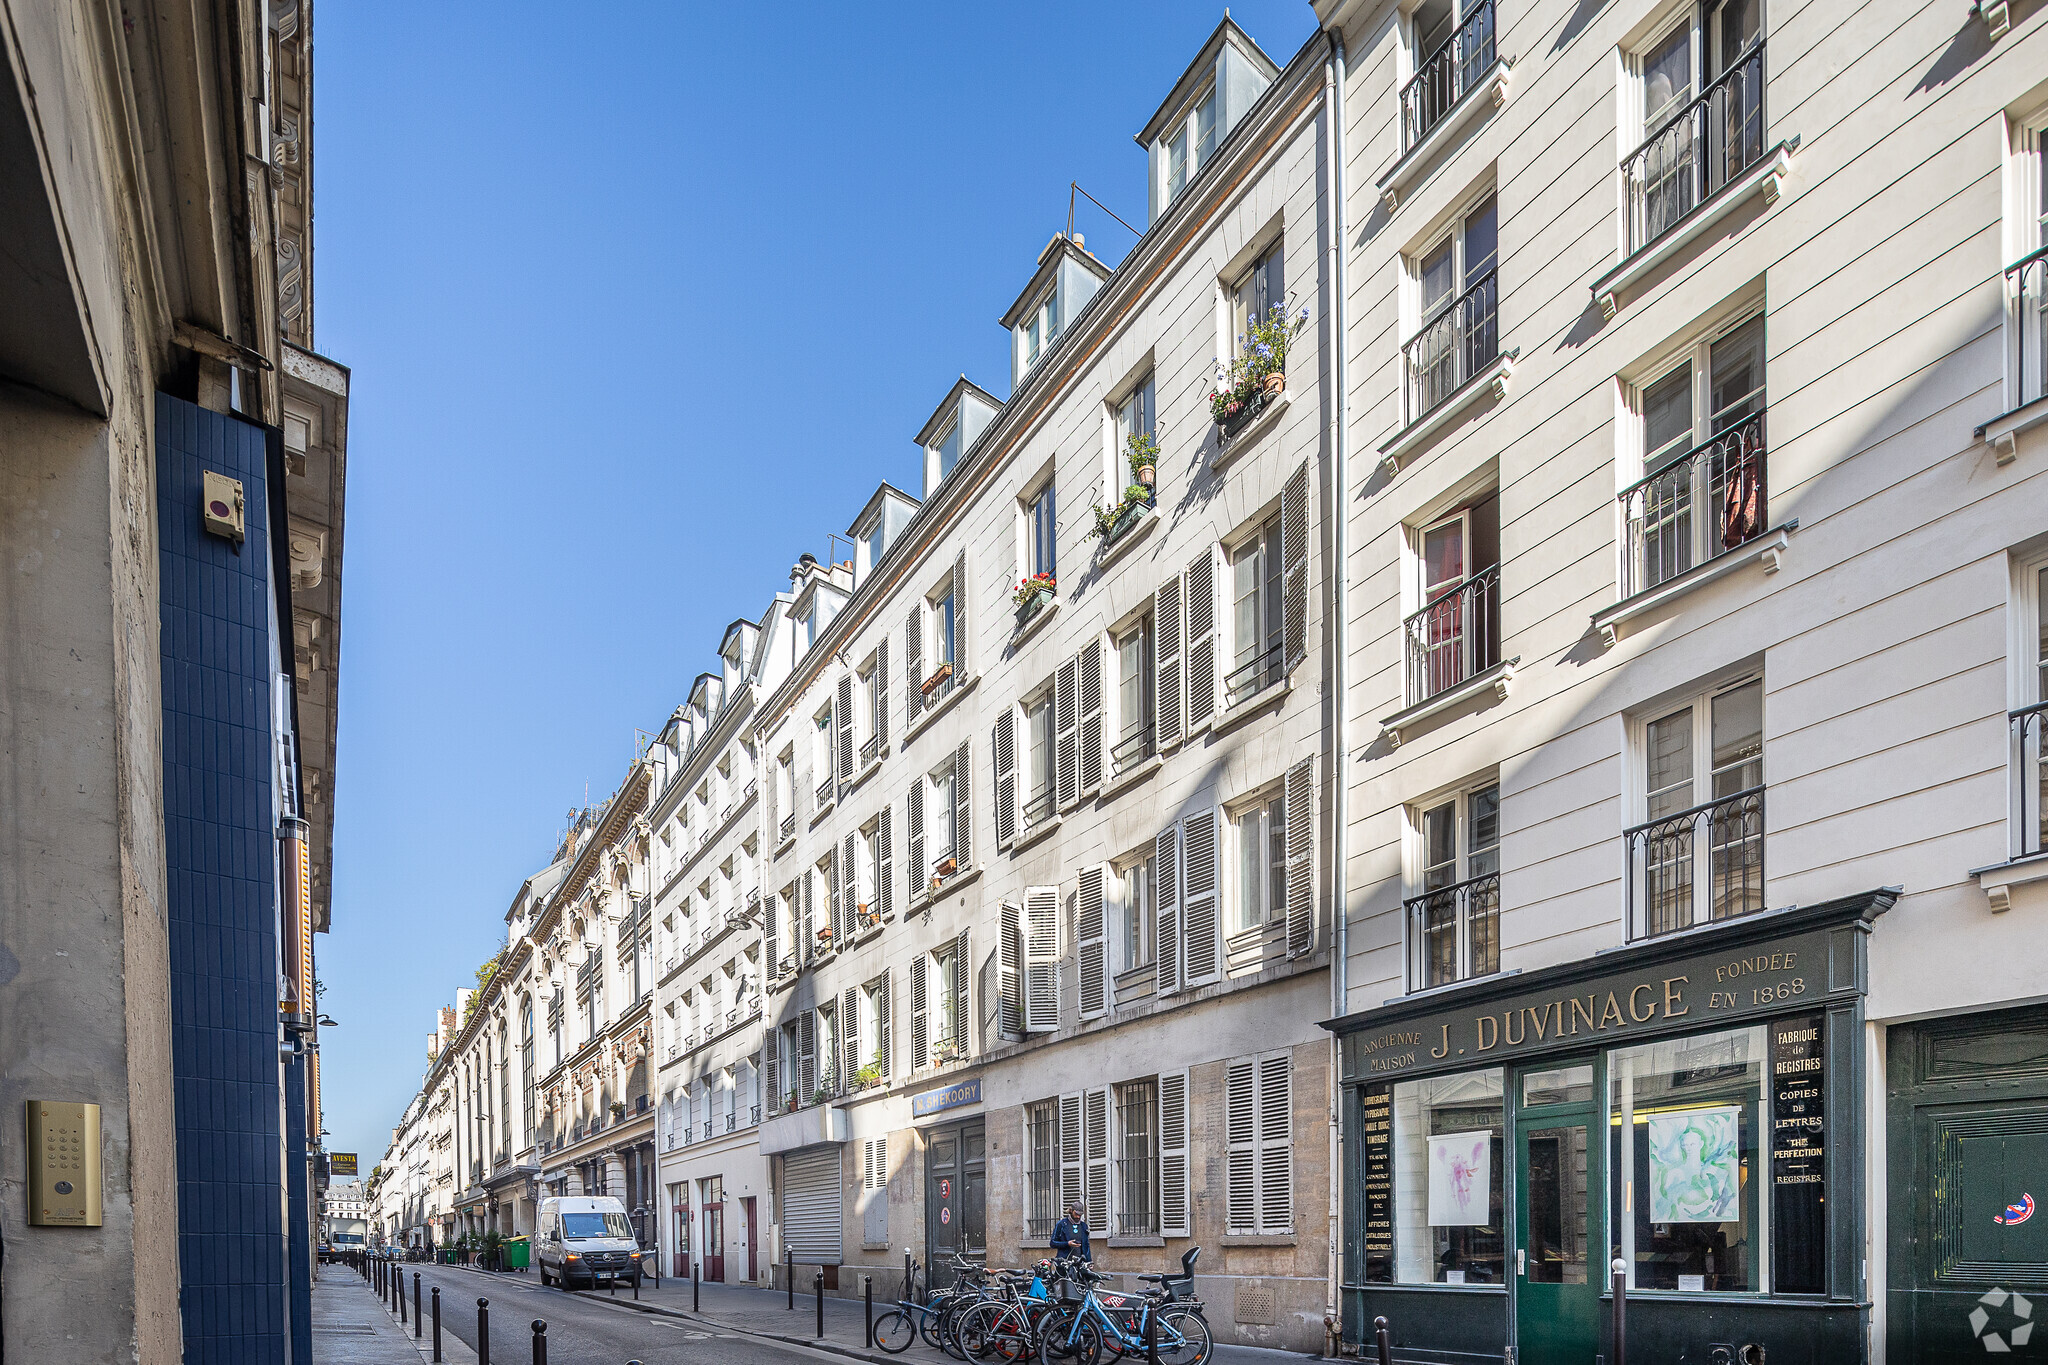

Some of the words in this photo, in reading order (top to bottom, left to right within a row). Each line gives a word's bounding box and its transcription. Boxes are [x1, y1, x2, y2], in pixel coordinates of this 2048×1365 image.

[1715, 949, 1798, 983] FONDÉE
[1708, 991, 1738, 1009] EN
[1752, 977, 1806, 1006] 1868
[1430, 1023, 1465, 1059] J.
[1475, 975, 1690, 1051] DUVINAGE
[1363, 1032, 1422, 1056] ANCIENNE
[1778, 1027, 1818, 1045] FABRIQUE
[1792, 1045, 1804, 1055] de
[1370, 1051, 1416, 1072] MAISON
[1776, 1057, 1821, 1075] REGISTRES
[926, 1085, 977, 1109] SHEKOORY
[1779, 1088, 1818, 1101] COPIES
[1792, 1104, 1805, 1113] DE
[1775, 1116, 1823, 1129] LETTRES
[1774, 1147, 1822, 1159] PERFECTION
[1777, 1174, 1822, 1183] REGISTRES
